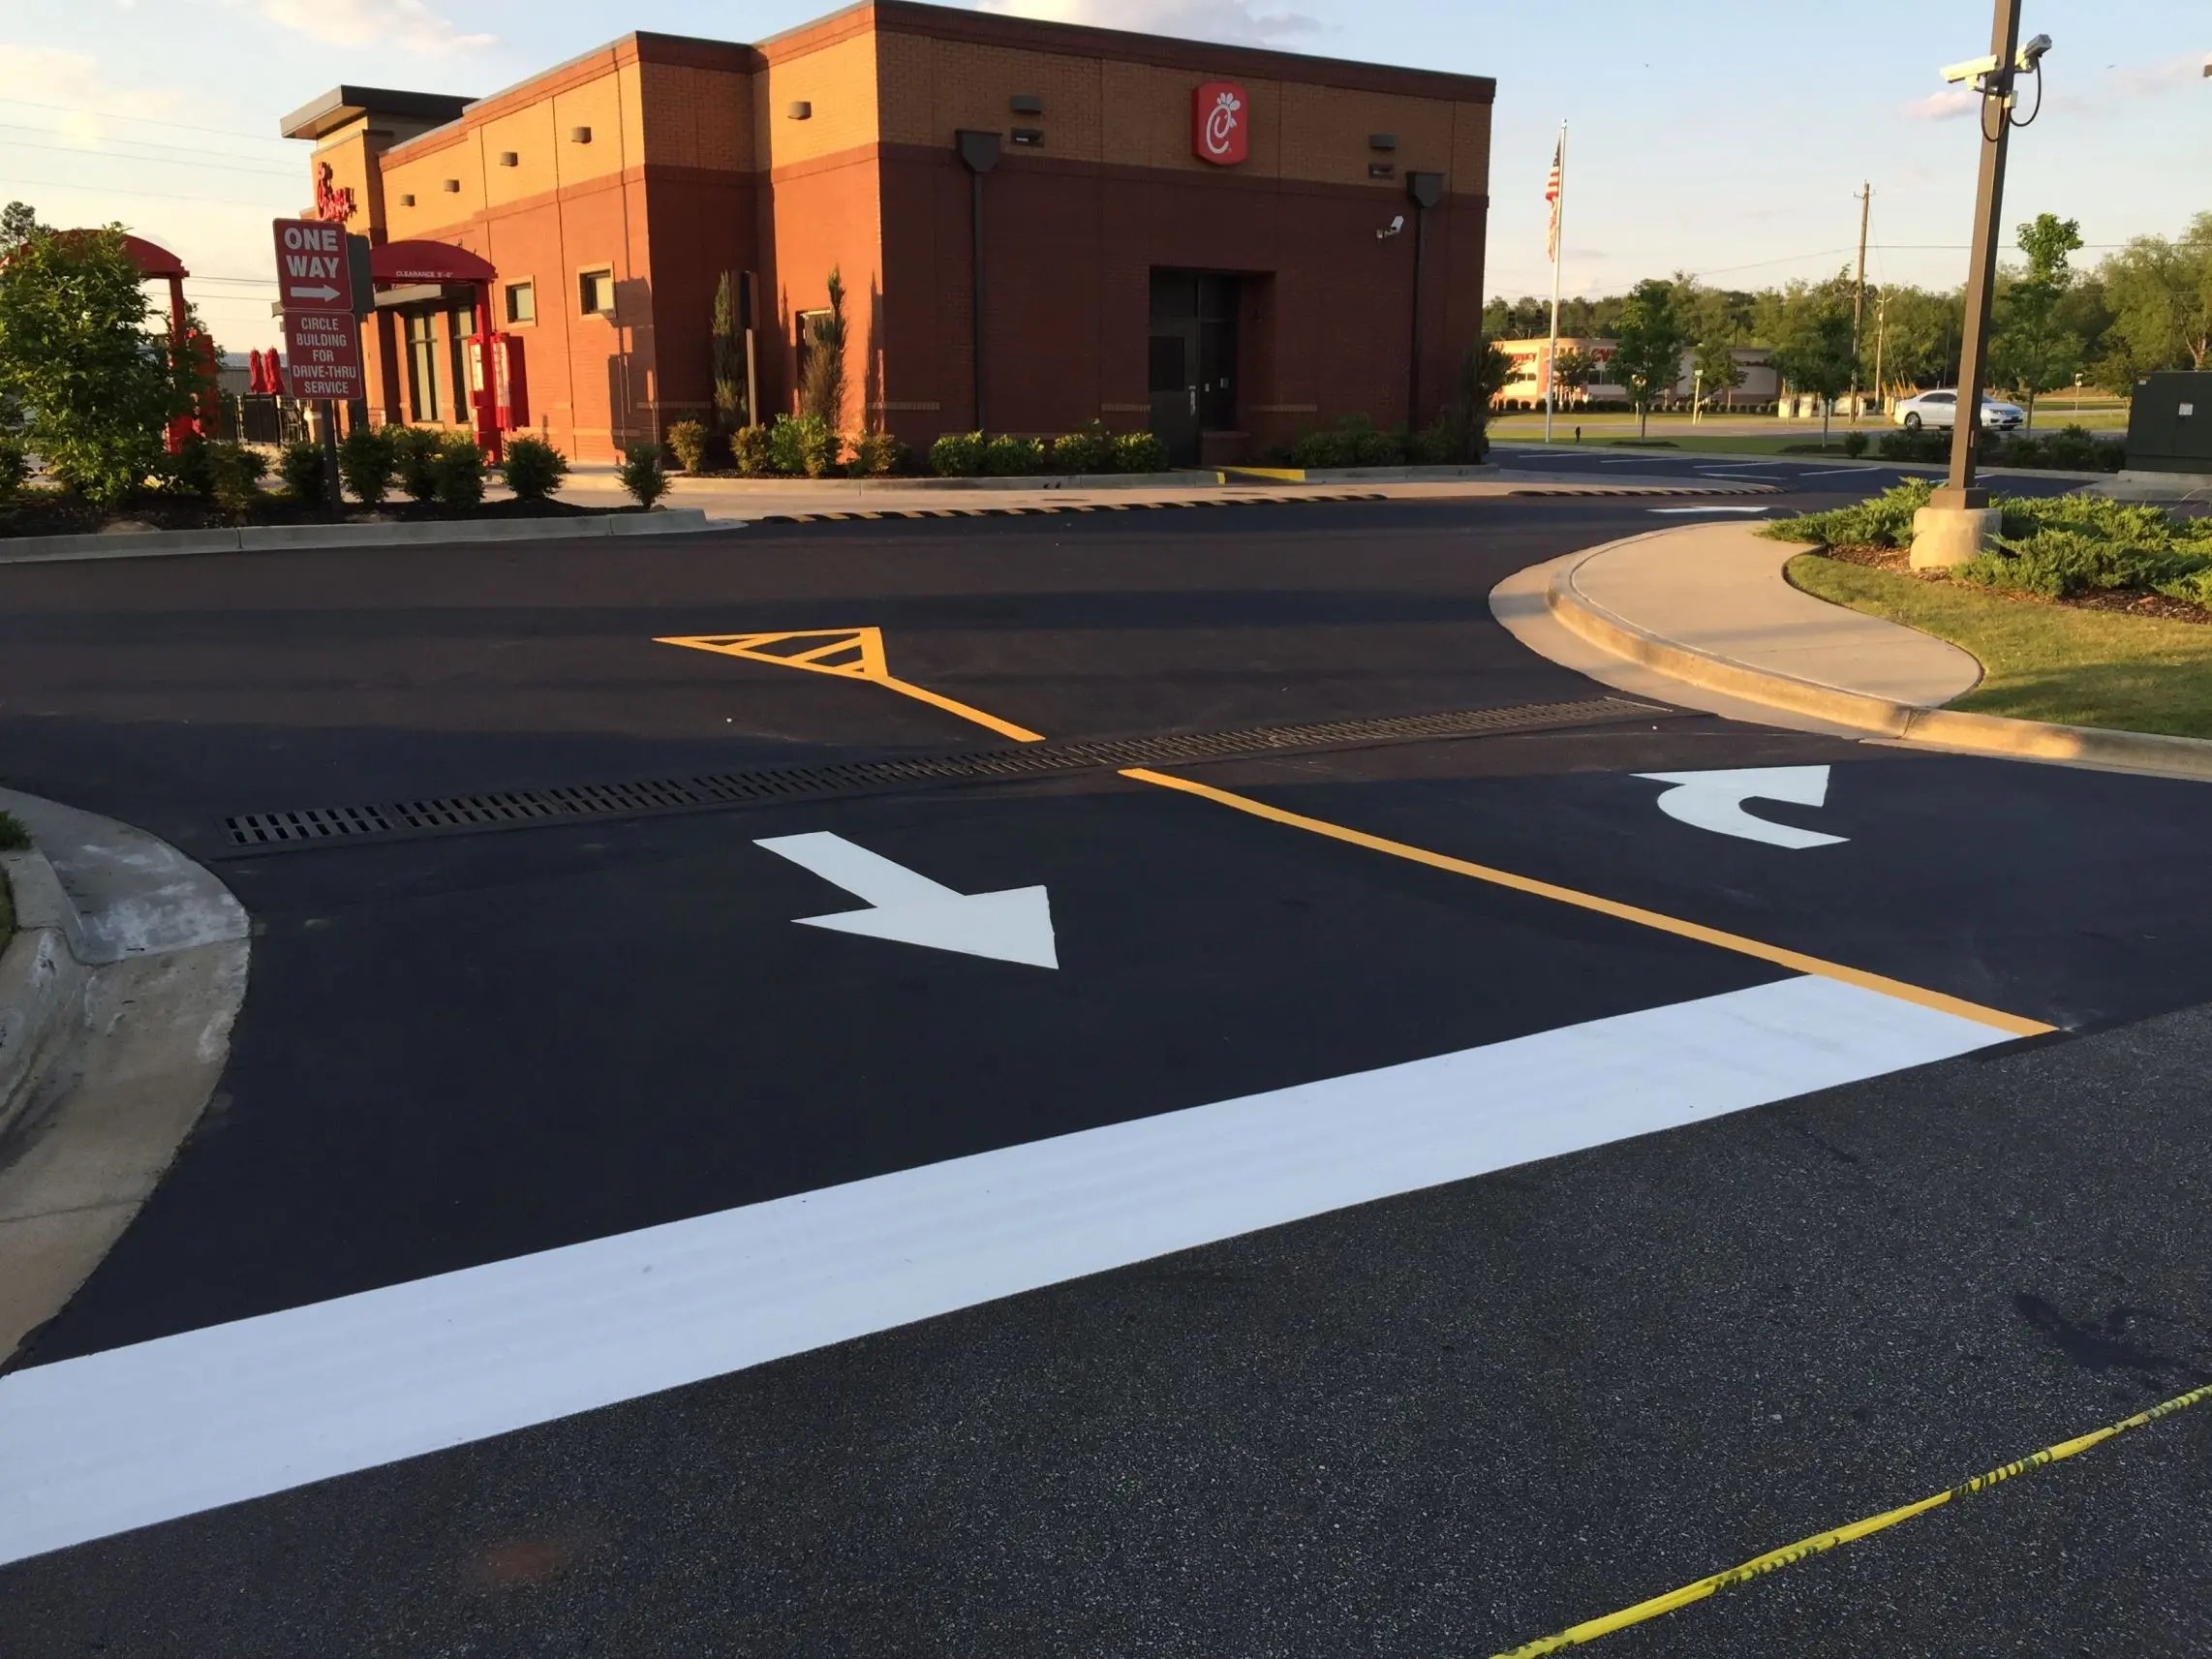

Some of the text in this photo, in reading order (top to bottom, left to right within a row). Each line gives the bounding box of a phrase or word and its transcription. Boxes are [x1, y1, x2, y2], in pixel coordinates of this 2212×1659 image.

[284, 227, 339, 252] ONE
[286, 255, 339, 278] WAY
[301, 317, 339, 331] CIRCLE
[296, 333, 347, 348] BUILDING
[312, 349, 334, 363] FOR
[292, 365, 356, 379] DRIVE-THRU
[304, 381, 349, 395] SERVICE
